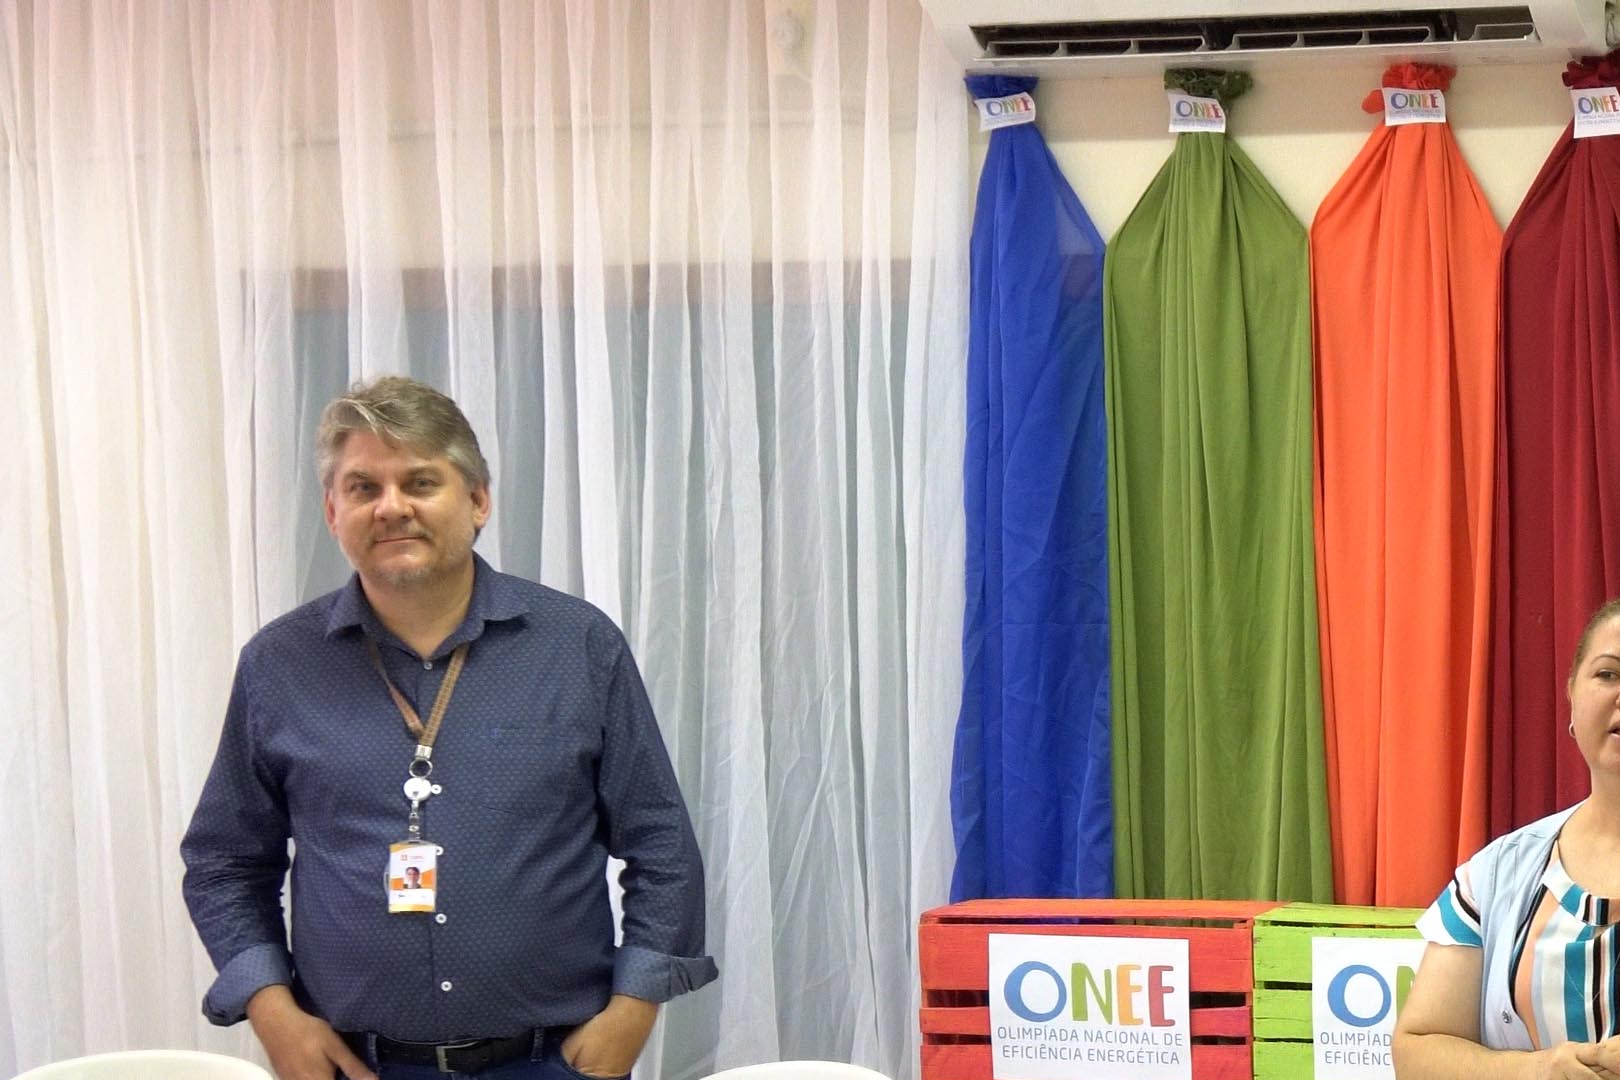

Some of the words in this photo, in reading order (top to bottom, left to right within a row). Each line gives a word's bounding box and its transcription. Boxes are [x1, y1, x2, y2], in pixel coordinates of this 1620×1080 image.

[986, 97, 1031, 116] ONEE
[1176, 100, 1222, 118] ONEE
[1391, 92, 1439, 110] ONEE
[1578, 95, 1619, 114] ONEE
[1003, 962, 1175, 1027] ONEE
[997, 1022, 1079, 1042] OLIMPÍADA
[1084, 1029, 1159, 1045] NACIONAL
[1164, 1033, 1182, 1046] DE
[1320, 1030, 1392, 1047] OLIMPÍAD
[1002, 1041, 1082, 1061] EFICIÊNCIA
[1088, 1047, 1180, 1064] ENERGÉTICA
